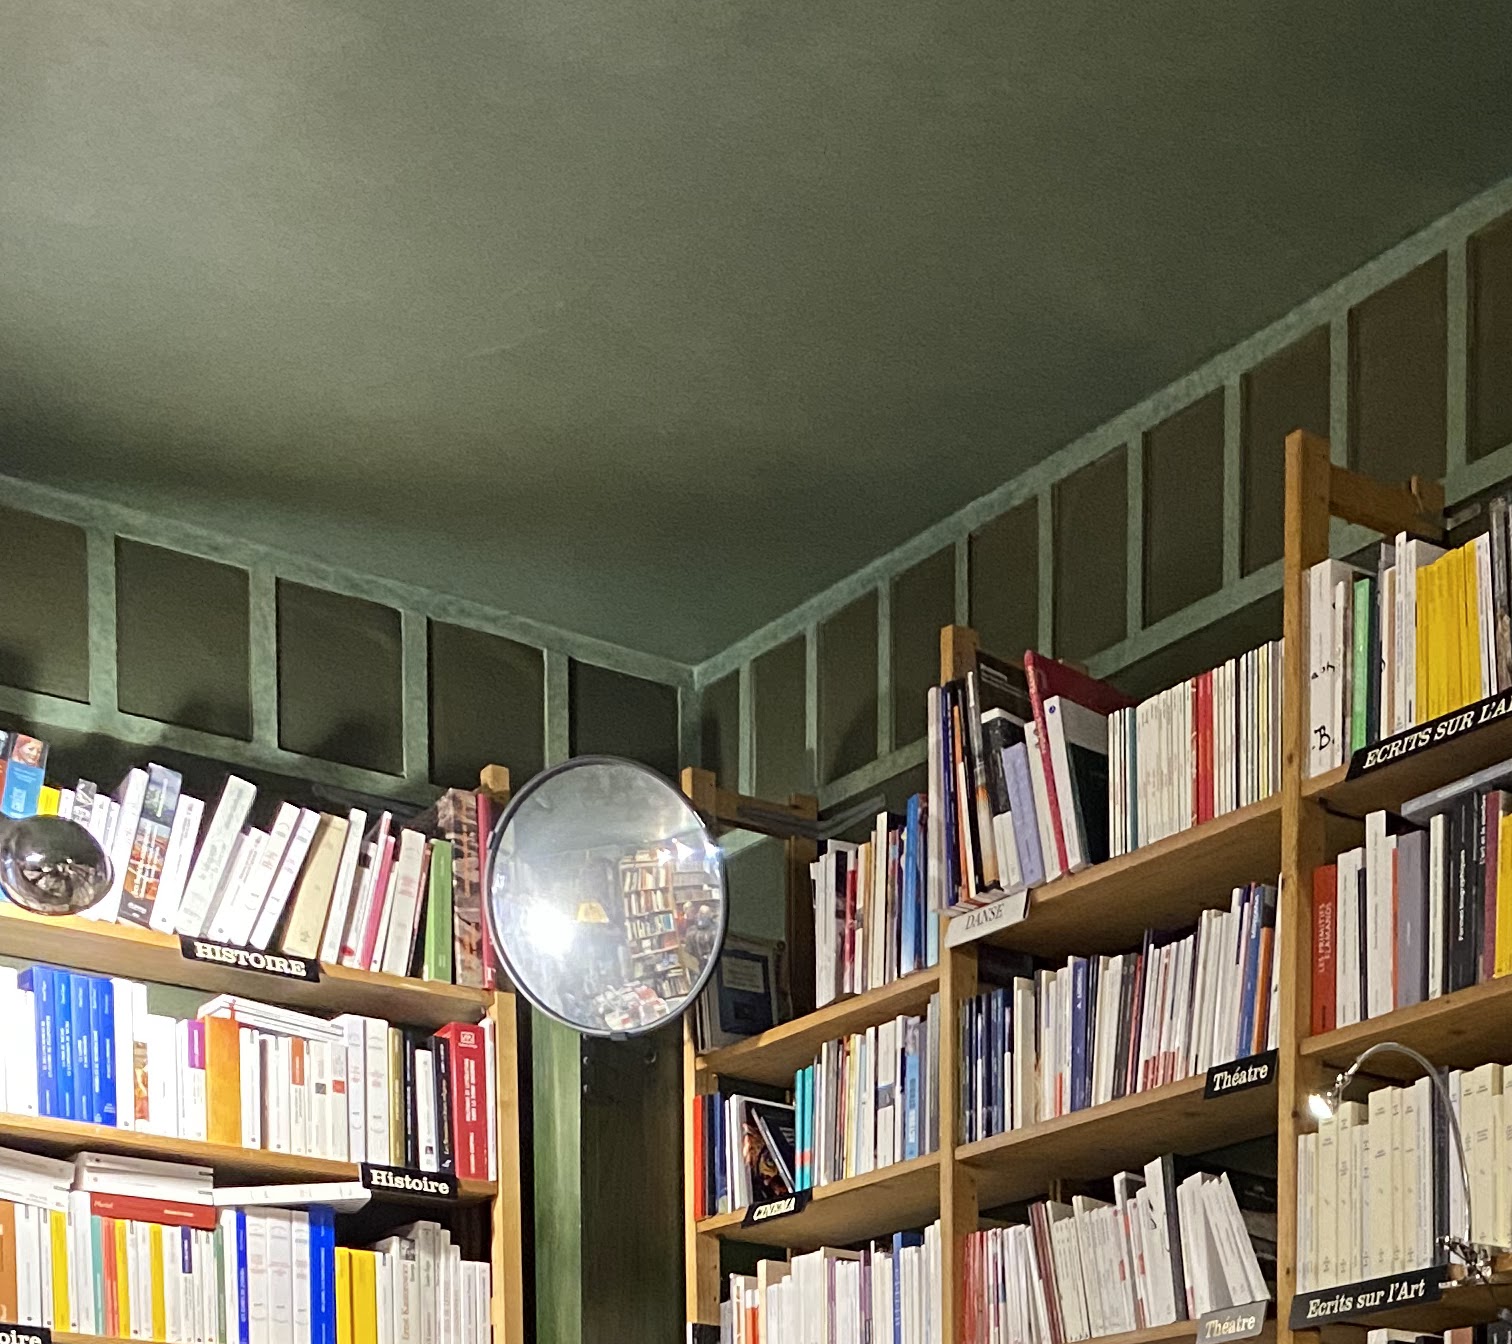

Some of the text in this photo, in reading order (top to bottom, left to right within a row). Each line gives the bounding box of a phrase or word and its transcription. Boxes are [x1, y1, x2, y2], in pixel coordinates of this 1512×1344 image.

[1363, 725, 1431, 770] ECRITS
[1433, 710, 1474, 742] SUR
[963, 902, 1004, 931] DANSE
[1324, 902, 1333, 959] FLAMANDS
[194, 941, 306, 976] HISTOIRE
[370, 1169, 450, 1194] Histoire
[1306, 1279, 1425, 1320] Ecrits sur l'Art
